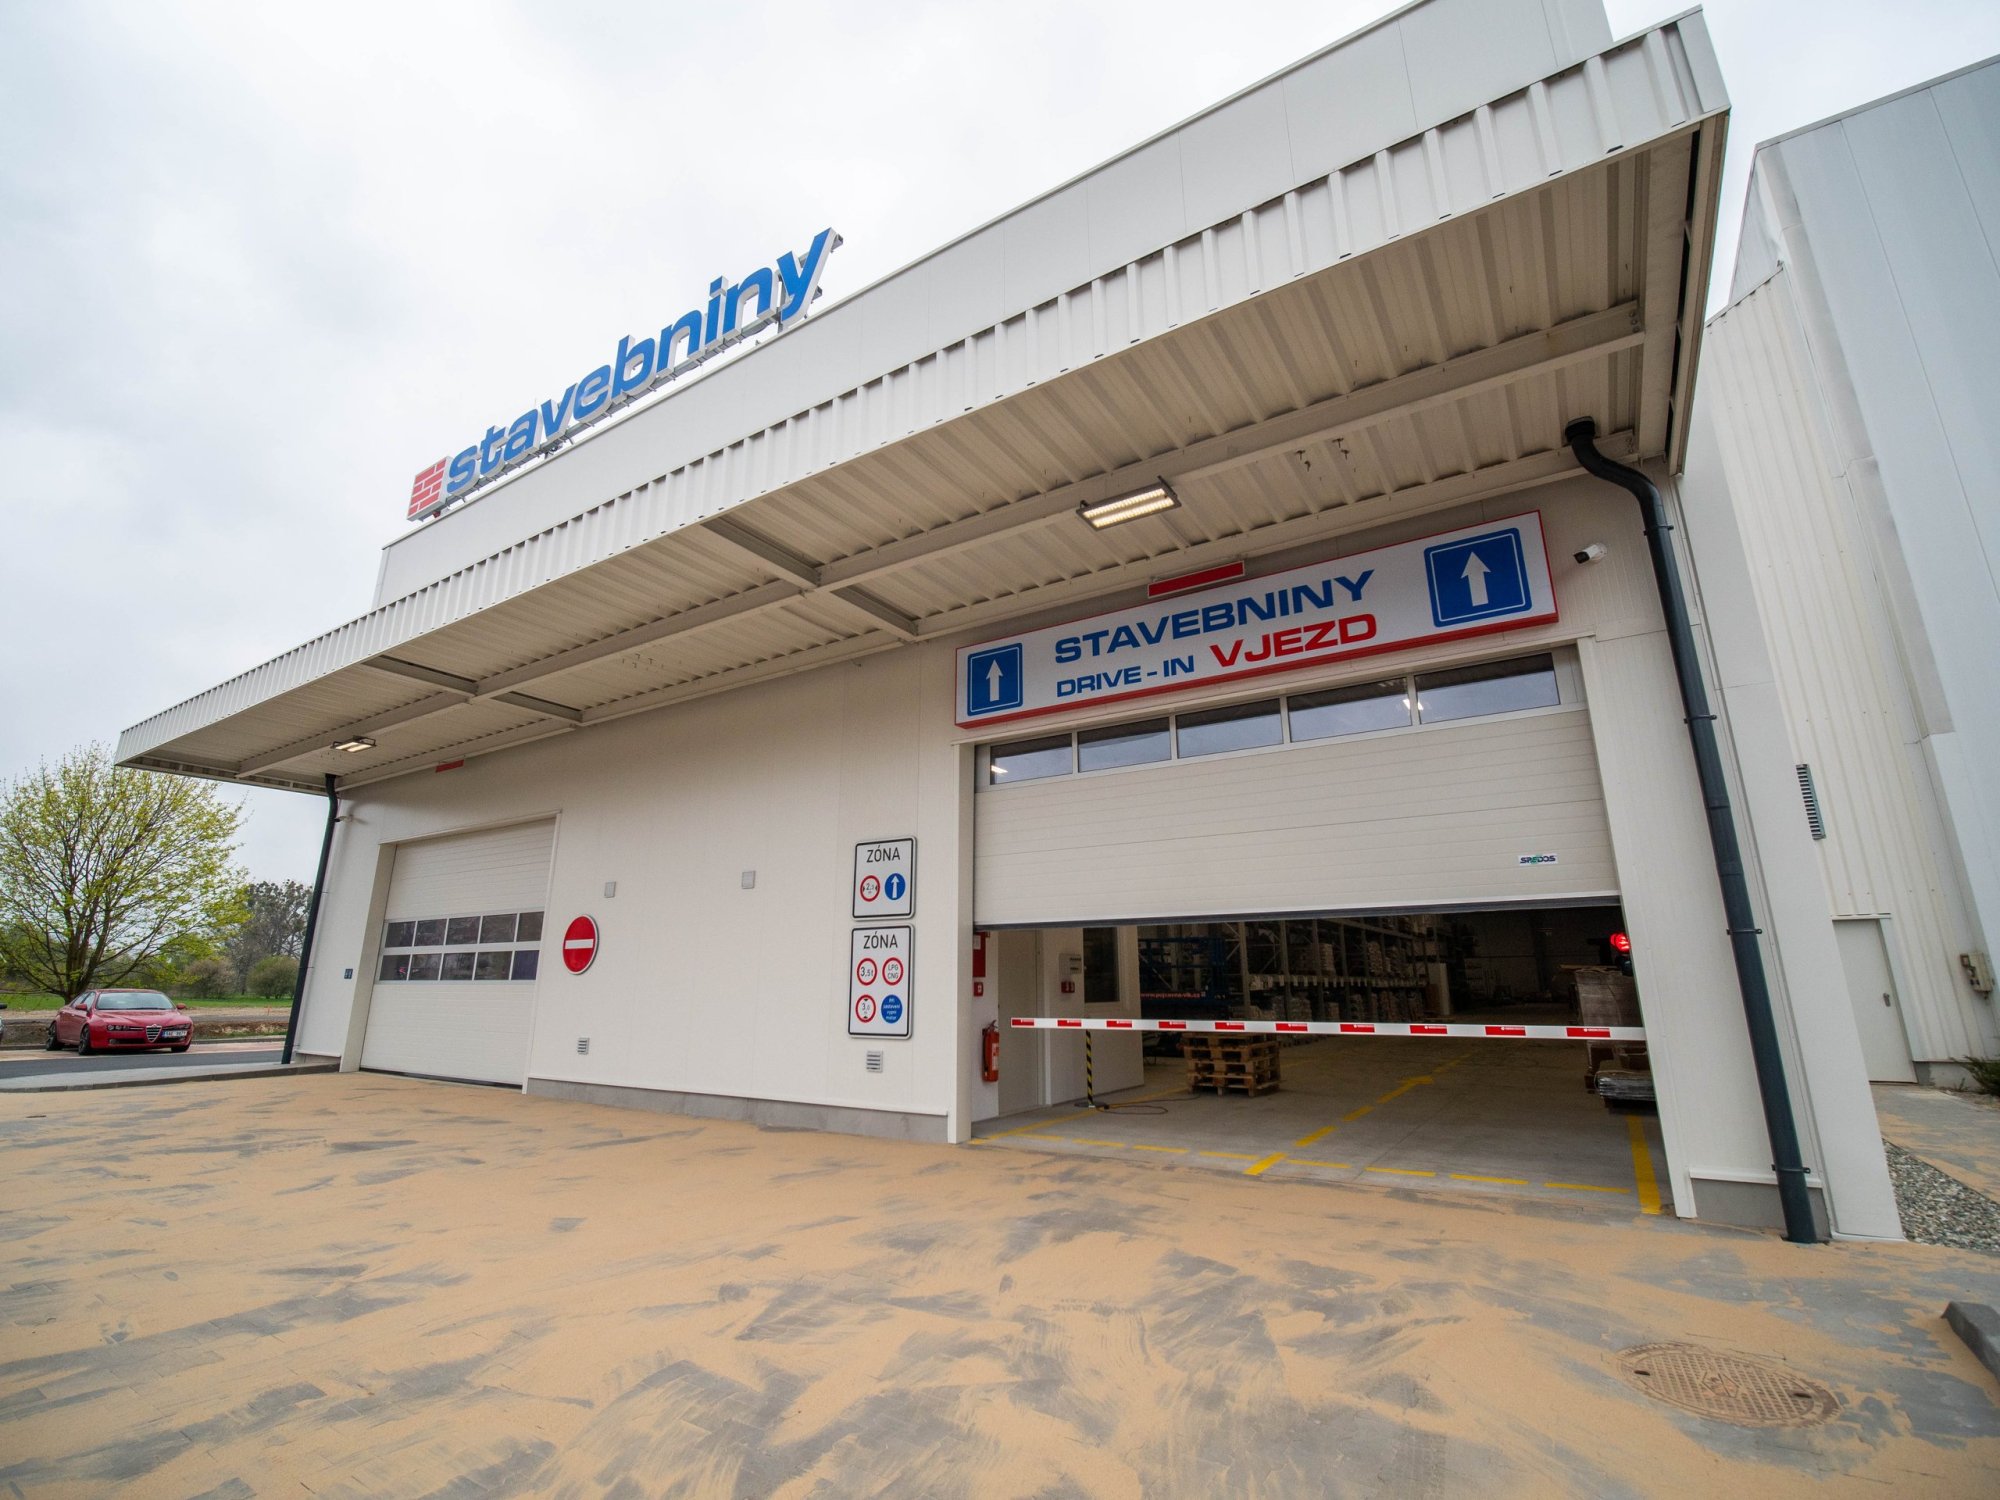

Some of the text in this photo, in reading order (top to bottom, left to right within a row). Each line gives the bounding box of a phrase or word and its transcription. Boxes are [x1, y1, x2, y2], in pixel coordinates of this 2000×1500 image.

[446, 227, 834, 495] stavebniny
[1055, 569, 1375, 664] STAVEBNINY
[1209, 613, 1377, 667] VJEZD
[866, 845, 901, 863] ZÓNA
[1520, 855, 1556, 864] SPEDOS
[863, 931, 899, 949] ZÓNA
